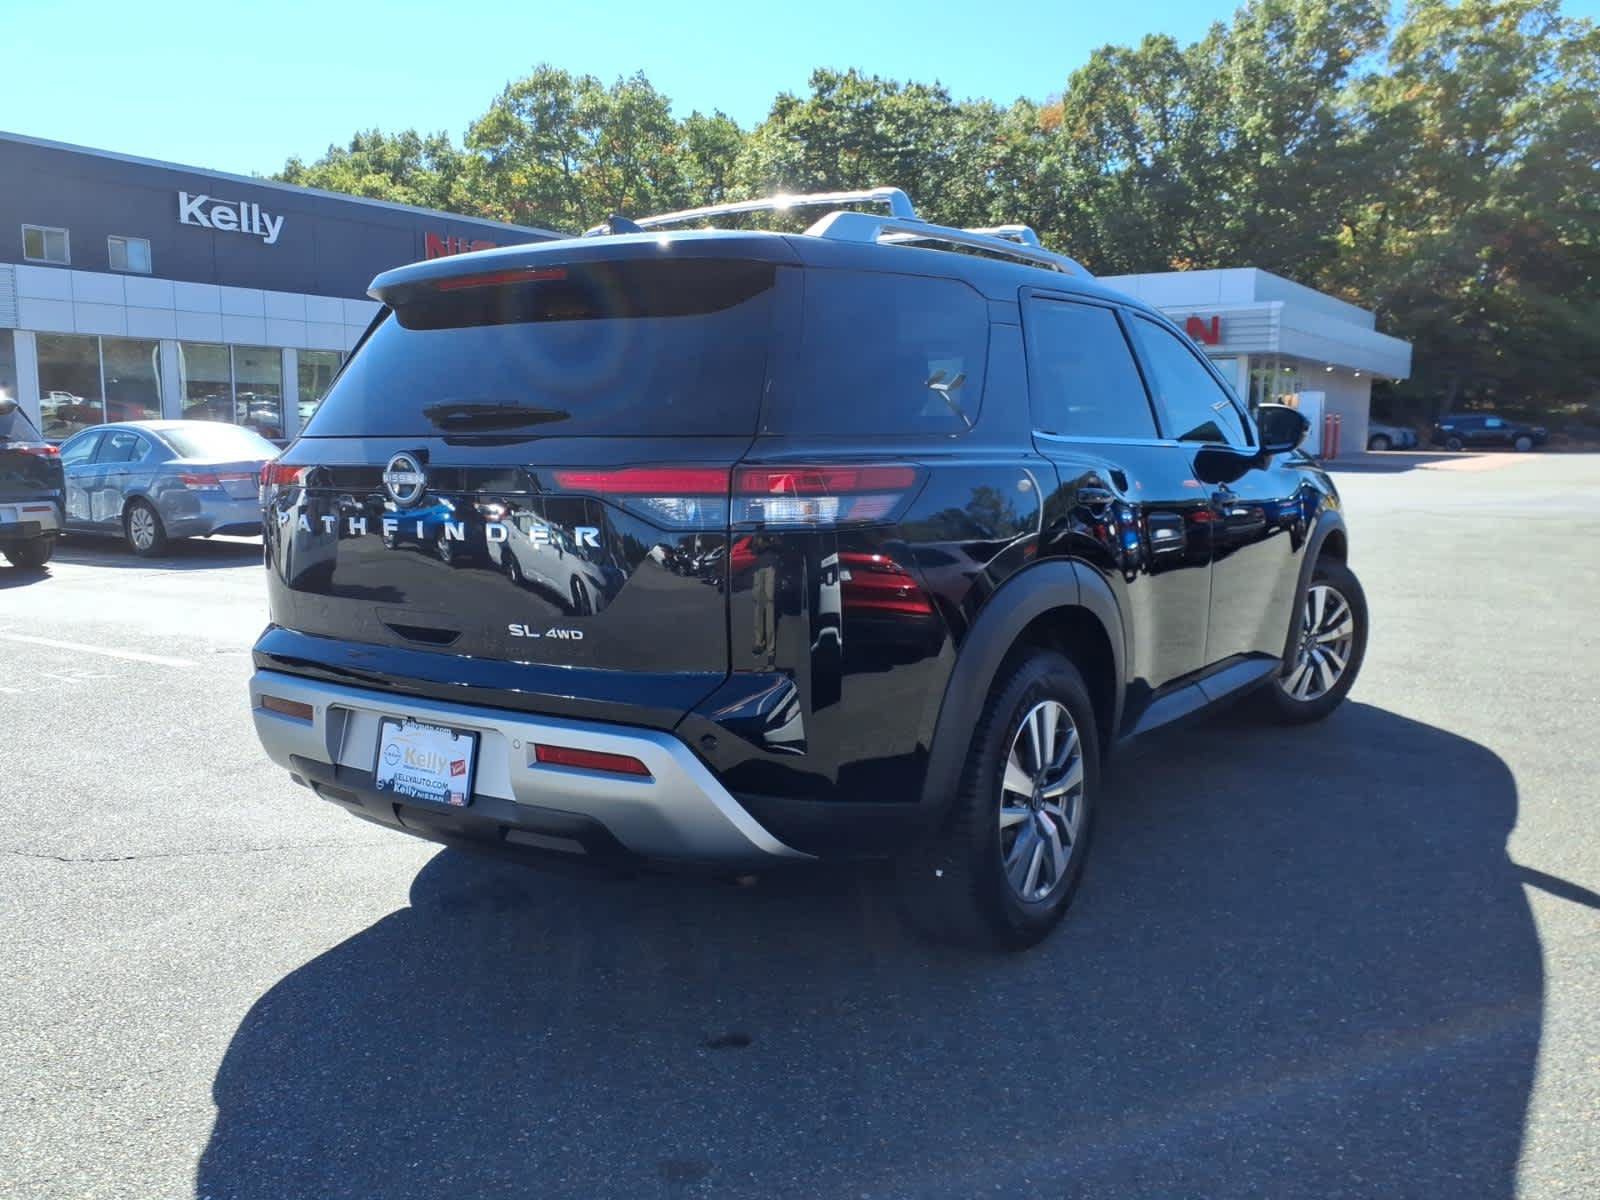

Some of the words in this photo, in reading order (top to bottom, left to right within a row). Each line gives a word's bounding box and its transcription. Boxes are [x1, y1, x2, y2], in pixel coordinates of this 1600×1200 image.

[178, 191, 285, 244] Kelly
[277, 510, 601, 547] PATHFINDER
[508, 623, 541, 638] SL
[545, 627, 584, 640] 4WD
[404, 747, 448, 775] Kelly
[393, 772, 449, 790] KELLYAUTO.COM
[393, 783, 418, 798] Kelly
